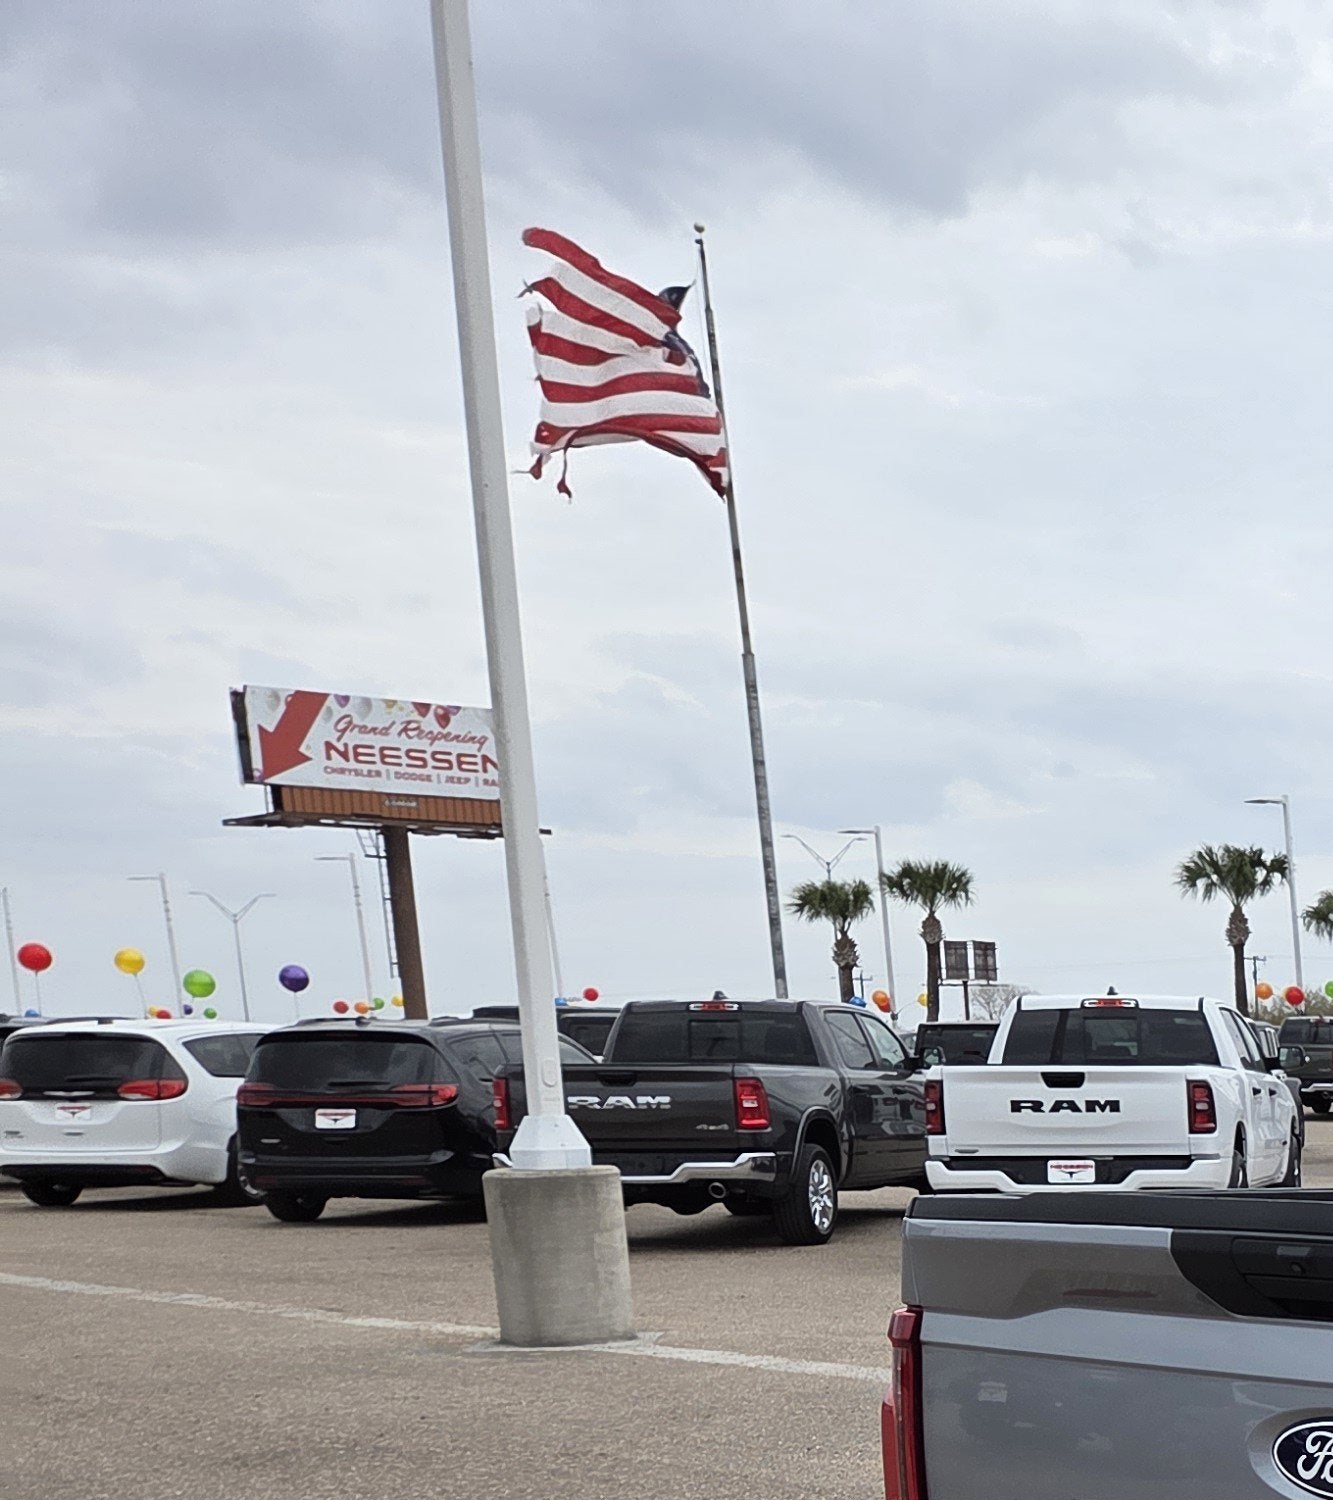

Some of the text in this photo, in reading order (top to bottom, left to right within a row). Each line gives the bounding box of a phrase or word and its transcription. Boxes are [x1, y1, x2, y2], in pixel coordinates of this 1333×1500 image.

[334, 714, 488, 751] Grand Reopening
[324, 741, 498, 773] NEESSEN
[324, 766, 498, 787] CHRYSLER DODGE JEEP RA
[567, 1095, 672, 1110] RAM
[1009, 1099, 1121, 1113] RAM
